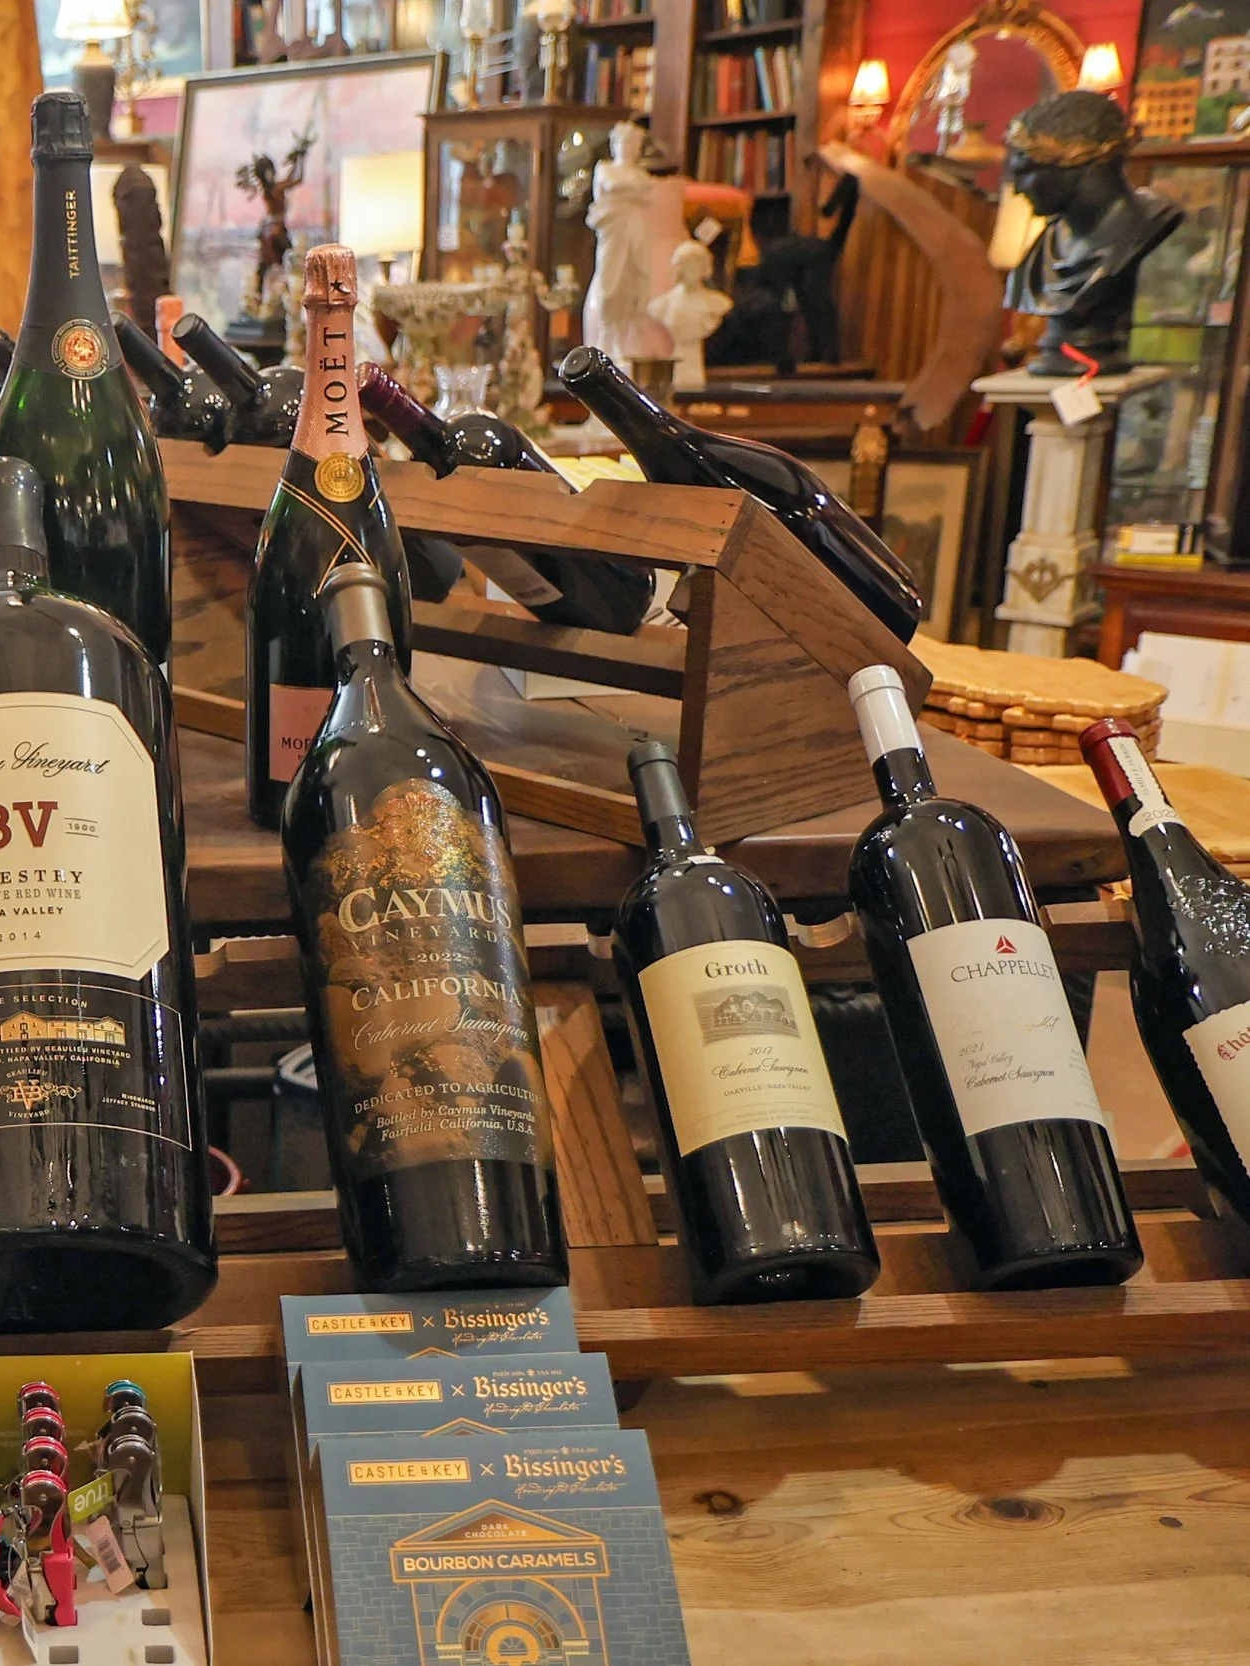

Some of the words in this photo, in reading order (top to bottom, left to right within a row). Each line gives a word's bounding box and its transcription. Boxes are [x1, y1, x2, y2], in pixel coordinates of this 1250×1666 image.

[65, 190, 80, 280] TAITTINGER
[323, 326, 350, 436] MOËT
[11, 741, 111, 778] Vineyard
[68, 822, 96, 832] 1900
[16, 888, 41, 900] RED
[47, 888, 82, 900] WINE
[14, 906, 64, 916] VALLEY
[338, 887, 512, 933] CAYMUS
[351, 925, 510, 950] VINEYARDS
[704, 959, 769, 979] Groth
[951, 960, 1055, 982] CHAPPELLET
[13, 995, 88, 1009] SELECTION
[352, 977, 522, 1011] CALIFORNIA
[352, 1017, 439, 1050] Cabernet
[444, 1007, 529, 1042] Sauvignon
[71, 1055, 120, 1066] CALIFORNIA
[92, 1048, 130, 1058] VINEYARD
[748, 1047, 773, 1055] 2017
[6, 1068, 48, 1078] BEAULIEU
[712, 1063, 761, 1079] Cabernet
[760, 1058, 808, 1076] Sauvignon
[966, 1073, 1007, 1090] Cabernet
[1008, 1065, 1055, 1083] Sauvignon
[354, 1085, 434, 1114] DEDICATED
[439, 1083, 460, 1094] TO
[8, 1109, 50, 1118] VINEYARD
[377, 1108, 416, 1129] Bottled
[420, 1107, 434, 1119] by
[438, 1104, 487, 1117] Caymus
[489, 1105, 535, 1122] Vineyards
[381, 1122, 435, 1141] Fairfield,
[439, 1117, 503, 1130] California,
[507, 1120, 536, 1135] U.S.A.
[312, 1318, 366, 1331] CASTLE
[381, 1316, 407, 1328] KEY
[442, 1307, 549, 1331] Bissinger's
[334, 1386, 391, 1399] CASTLE
[407, 1384, 435, 1397] KEY
[473, 1376, 587, 1401] Bissinger's
[355, 1465, 417, 1479] CASTLE
[433, 1463, 461, 1477] KEY
[503, 1454, 626, 1481] Bissinger's
[74, 1482, 112, 1512] true
[465, 1529, 528, 1538] CHOCOLATE
[481, 1523, 509, 1531] DARK
[403, 1556, 494, 1571] BOURBON
[497, 1552, 596, 1570] CARAMELS
